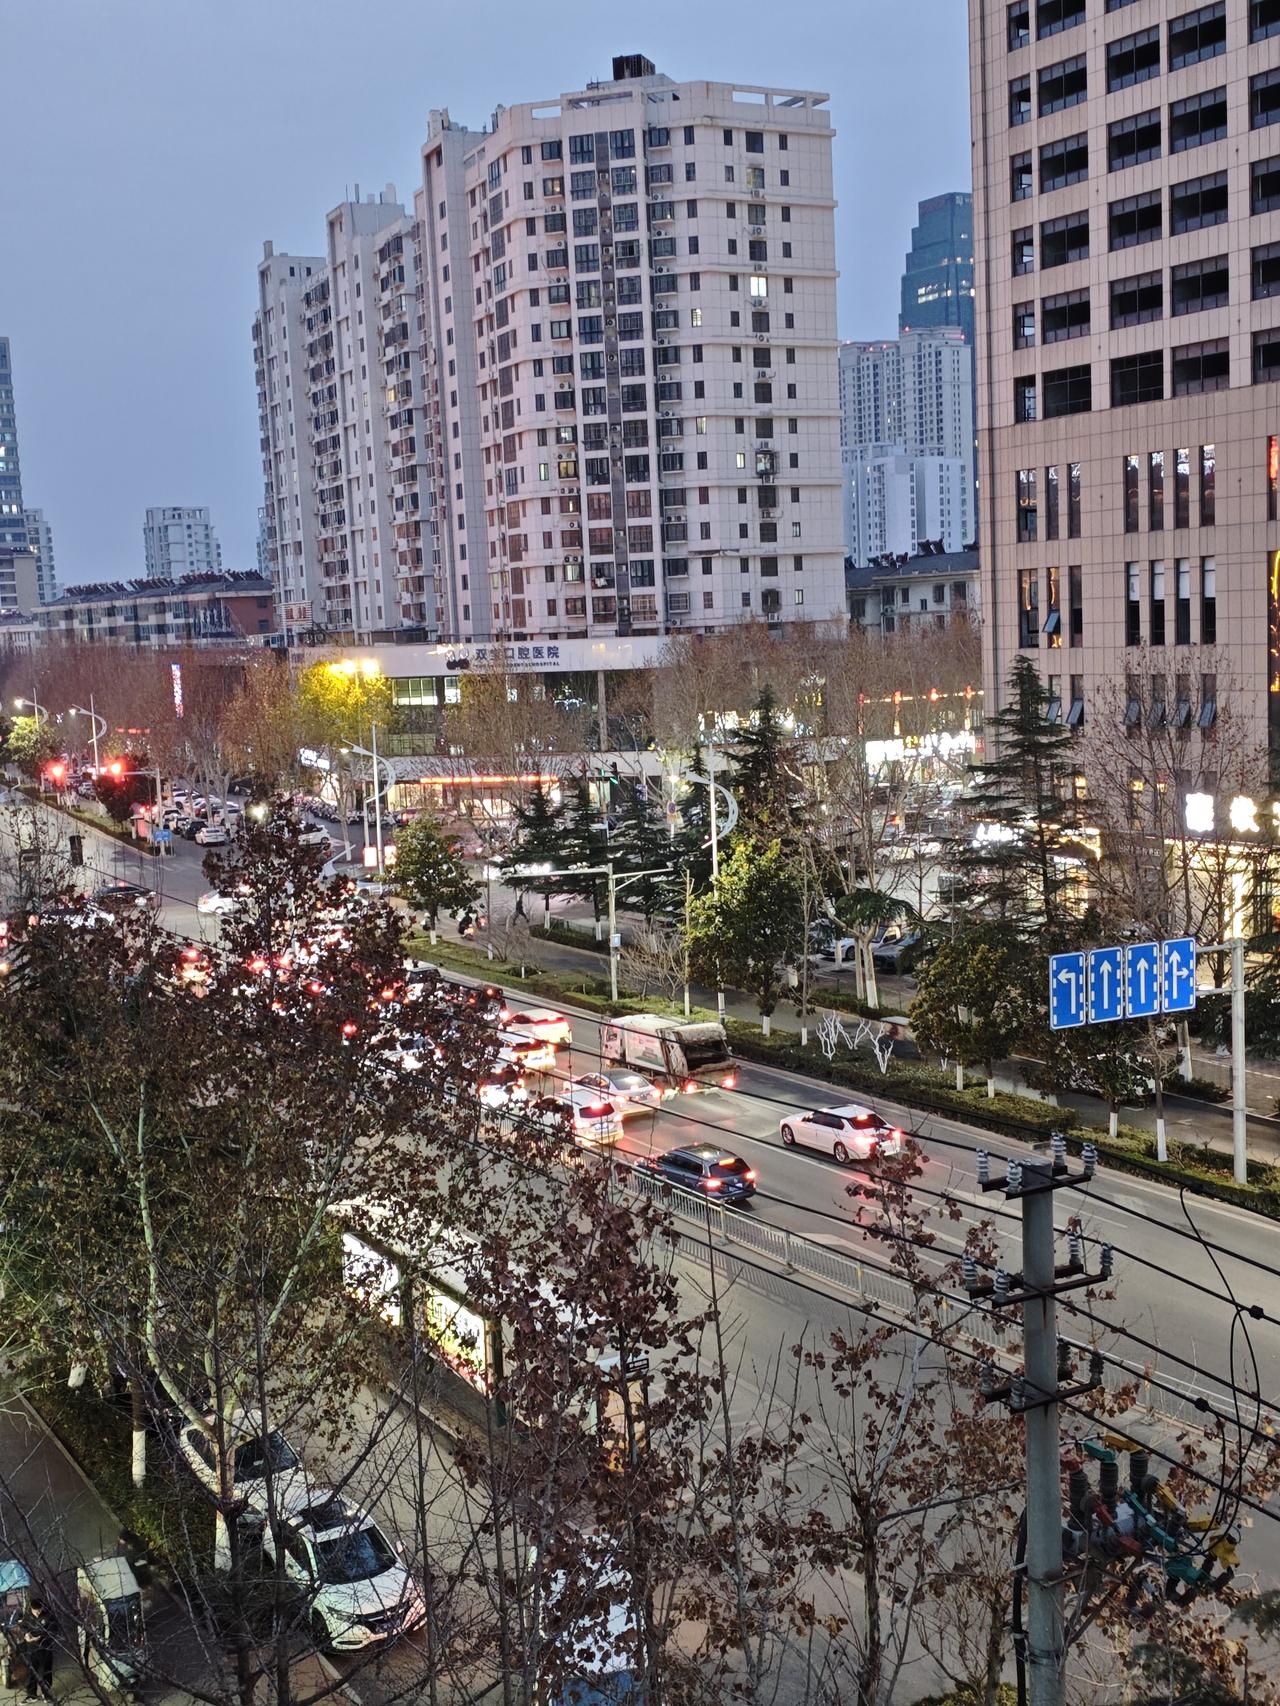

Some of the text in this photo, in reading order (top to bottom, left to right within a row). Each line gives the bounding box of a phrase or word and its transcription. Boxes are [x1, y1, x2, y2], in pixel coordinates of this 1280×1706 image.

[475, 646, 559, 661] 双口腔医院
